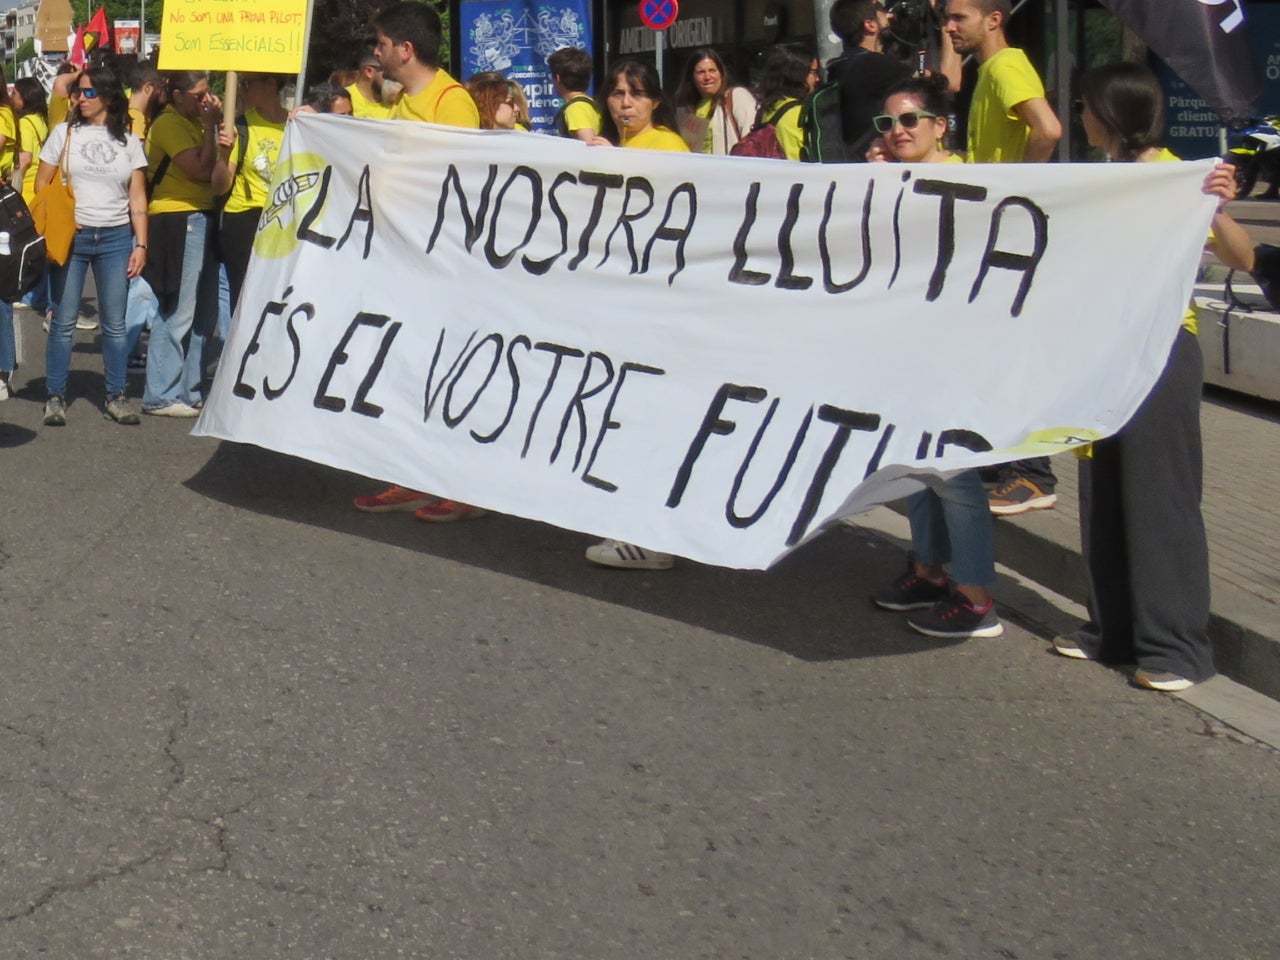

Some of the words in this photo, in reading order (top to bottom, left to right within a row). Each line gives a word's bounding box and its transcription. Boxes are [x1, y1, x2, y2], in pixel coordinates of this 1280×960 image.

[216, 11, 234, 24] UNA
[240, 11, 266, 24] PROVA
[670, 16, 713, 49] ORIGEN
[1169, 96, 1209, 110] Pàrqu
[296, 163, 375, 260] LA
[425, 163, 698, 287] NOSTRA
[231, 285, 316, 401] ÉS
[312, 311, 403, 419] EL
[422, 327, 666, 493] VOSTRE
[664, 382, 994, 548] FUT
